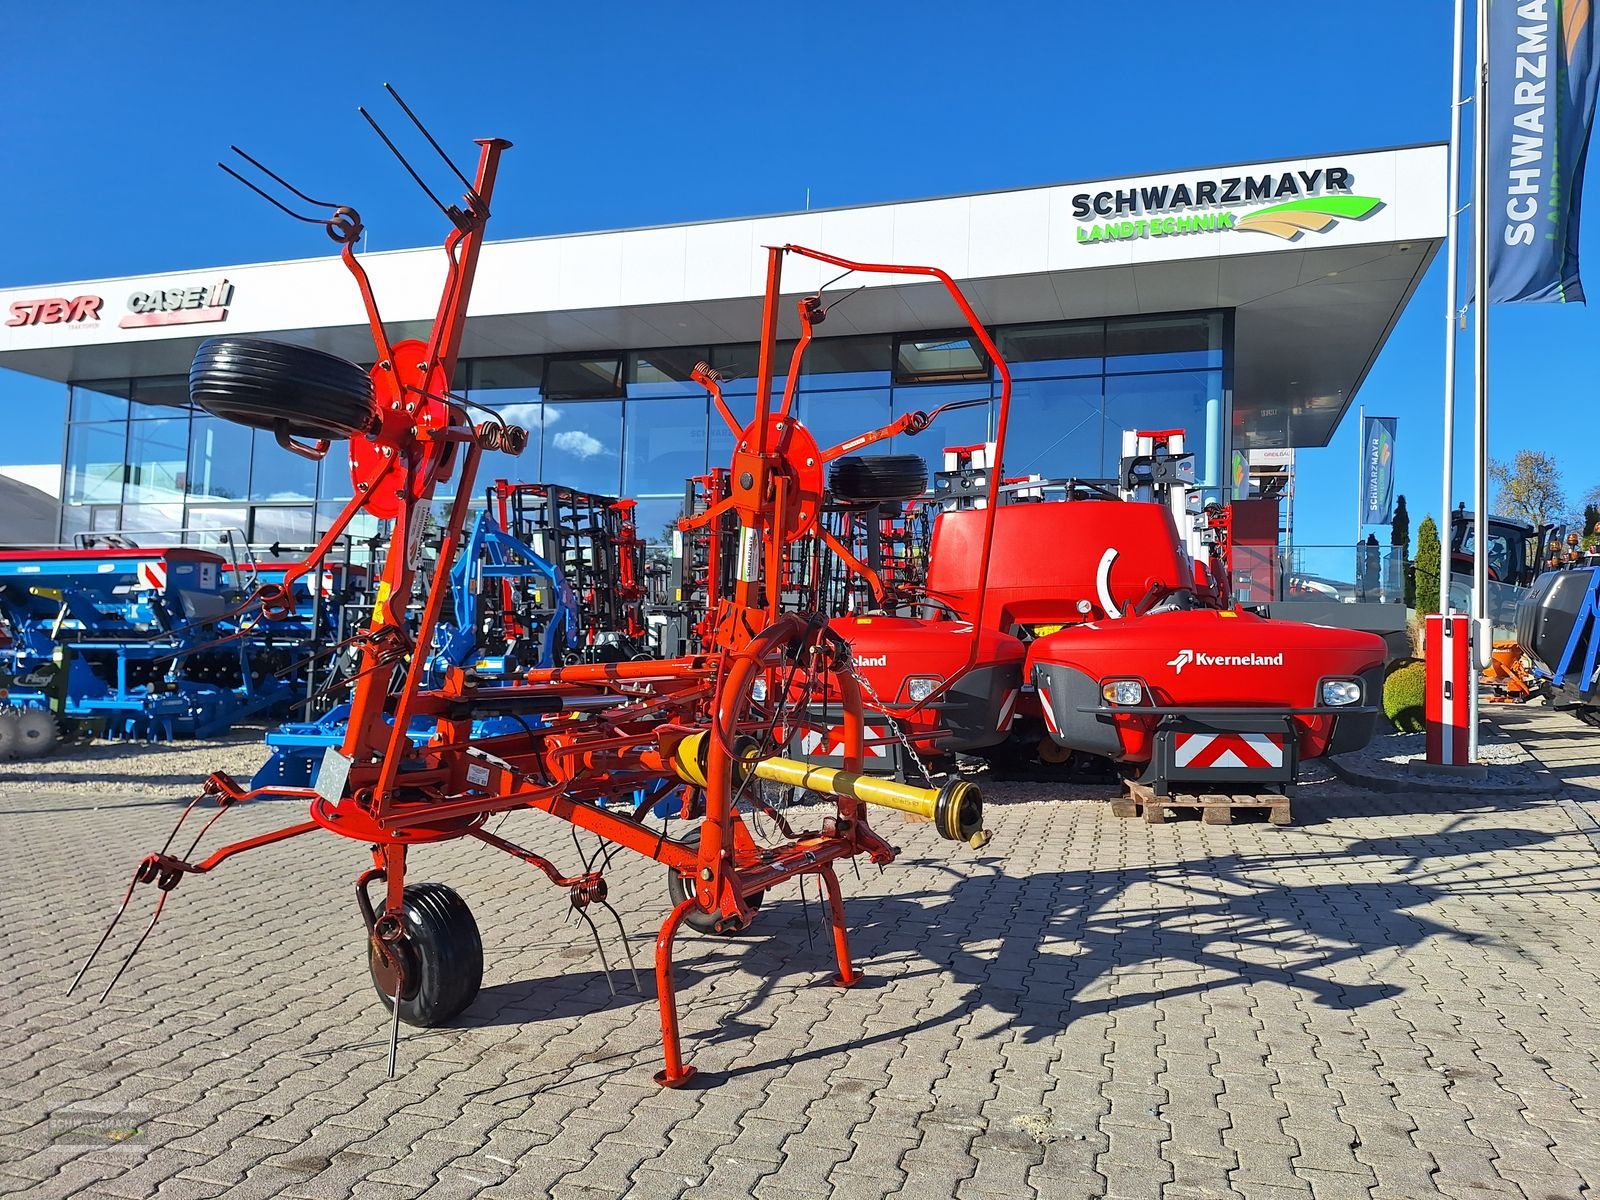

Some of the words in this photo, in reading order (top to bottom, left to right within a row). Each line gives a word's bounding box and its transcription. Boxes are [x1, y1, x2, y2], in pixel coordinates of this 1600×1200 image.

[1504, 0, 1548, 247] SCHWARZMA
[1071, 166, 1350, 218] SCHWARZMAYR
[1076, 211, 1234, 243] LANDTECHNIK
[5, 295, 103, 327] STEYR
[126, 287, 206, 314] CASE
[1370, 438, 1379, 511] SCHWARZMAYR
[851, 655, 887, 666] eland
[1196, 653, 1284, 666] Kverneland
